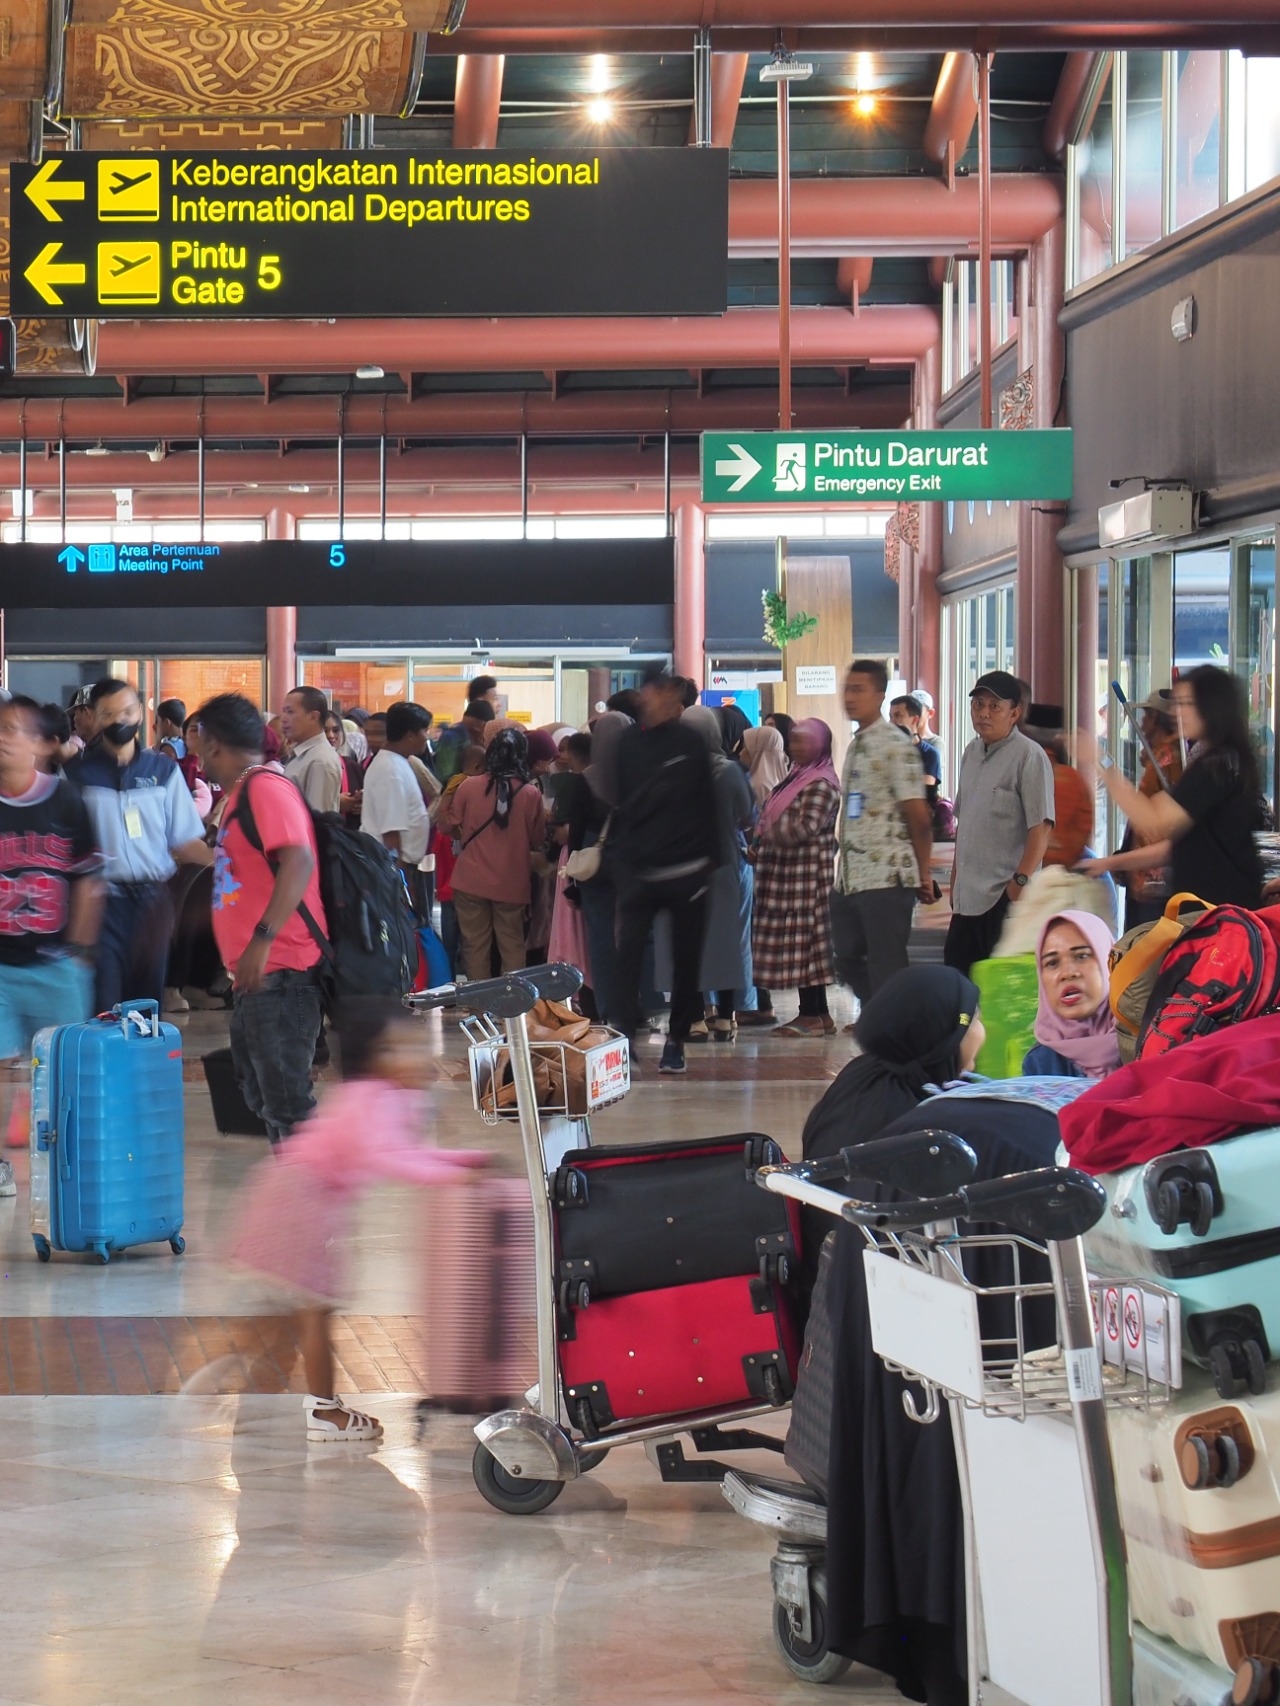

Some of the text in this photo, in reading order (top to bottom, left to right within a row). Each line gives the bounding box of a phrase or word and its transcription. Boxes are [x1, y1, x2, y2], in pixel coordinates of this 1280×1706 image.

[172, 157, 600, 192] Keberangkatan Internasional
[172, 194, 531, 228] International Departures
[171, 241, 247, 269] Pintu
[257, 255, 282, 291] 5
[171, 275, 245, 305] Gate
[814, 442, 988, 467] Pintu Darurat
[814, 474, 941, 494] Emergency Exit
[118, 543, 220, 556] Area Pertemuan
[329, 544, 346, 568] 5
[118, 558, 204, 574] Meeting Point
